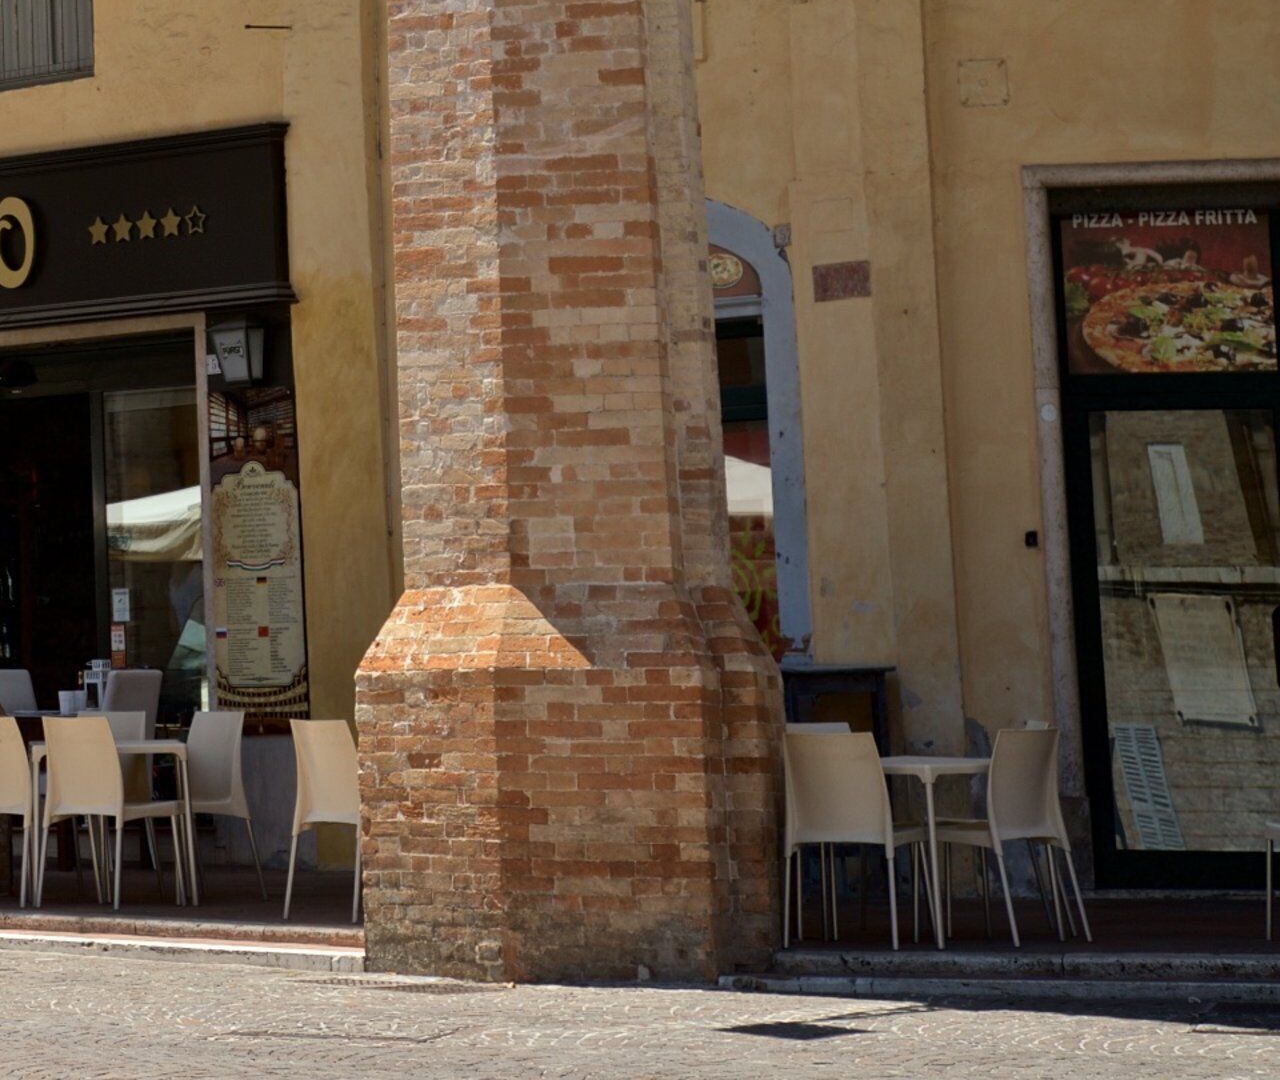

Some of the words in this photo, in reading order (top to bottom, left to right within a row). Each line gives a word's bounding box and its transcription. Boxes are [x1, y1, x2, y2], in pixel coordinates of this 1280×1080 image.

[1071, 212, 1123, 229] PIZZA
[1138, 210, 1190, 227] PIZZA
[1195, 208, 1258, 225] FRITTA
